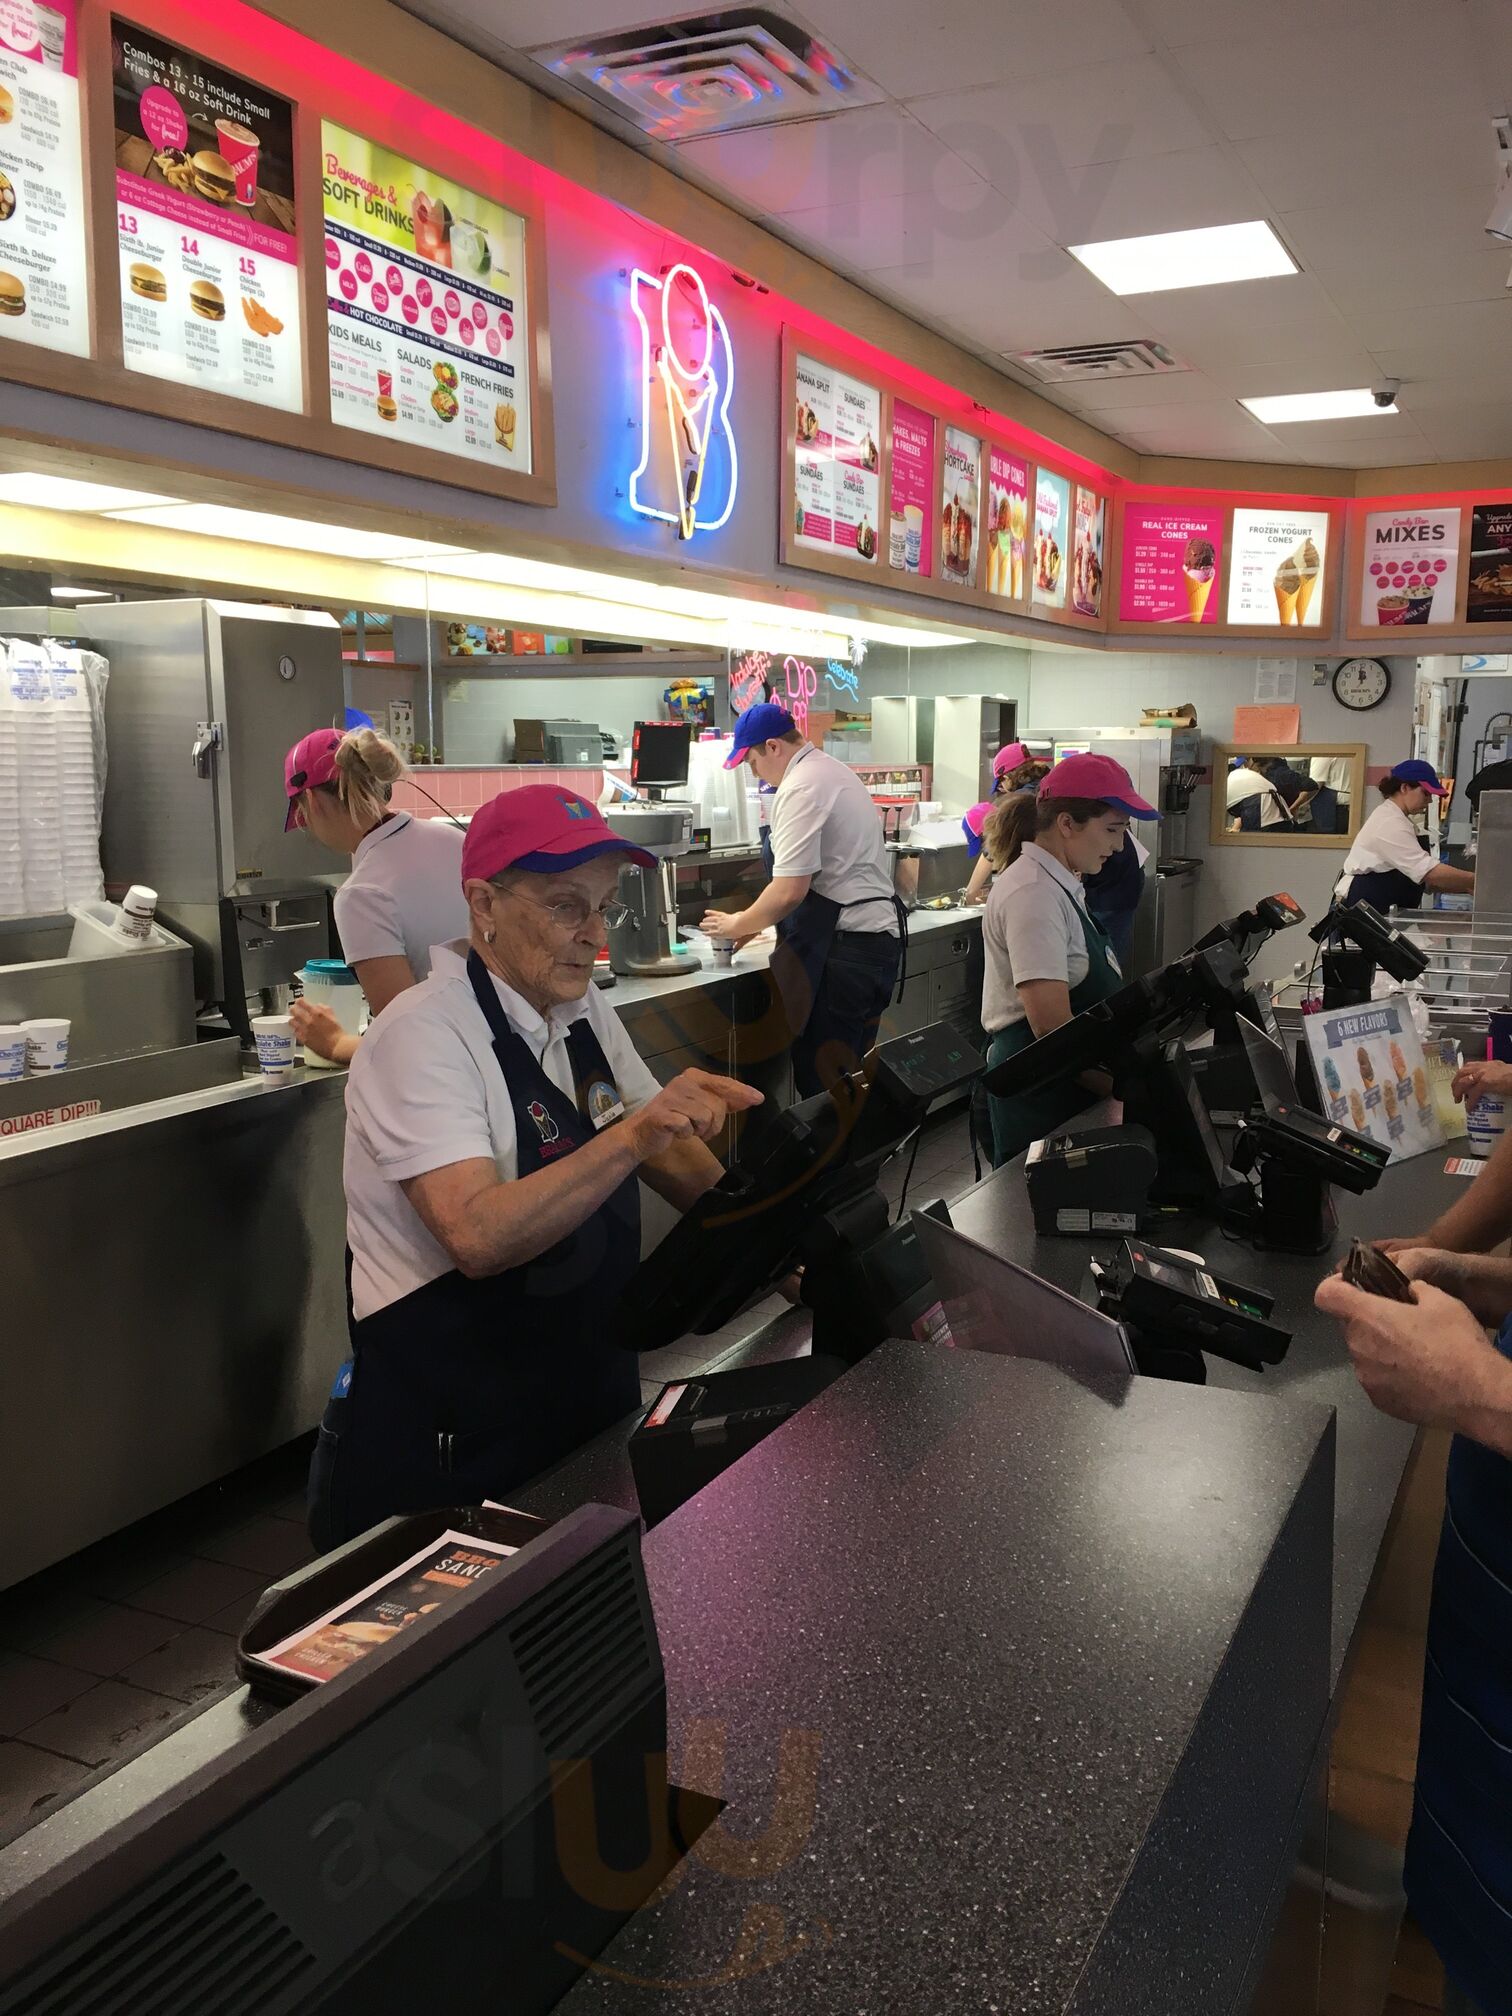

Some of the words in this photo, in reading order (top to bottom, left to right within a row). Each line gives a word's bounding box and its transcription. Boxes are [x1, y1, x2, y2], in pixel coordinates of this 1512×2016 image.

[10, 60, 28, 74] Club
[123, 42, 166, 70] Combos
[169, 63, 182, 78] 13
[192, 74, 205, 88] 15
[207, 80, 242, 106] include
[244, 98, 270, 119] Small
[124, 57, 150, 78] Fries
[152, 71, 160, 84] &
[164, 79, 170, 88] a
[174, 80, 186, 95] 16
[189, 91, 200, 102] oz
[203, 94, 224, 112] Soft
[226, 104, 252, 126] Drink
[25, 159, 44, 172] Strip
[325, 154, 386, 203] Beverages
[384, 186, 398, 207] &
[142, 196, 166, 212] Cottage
[148, 187, 166, 200] Greek
[167, 194, 186, 208] Yogurt
[323, 178, 361, 210] SOFT
[364, 200, 414, 235] DRINKS
[119, 213, 138, 234] 13
[120, 234, 136, 244] Sixth
[146, 242, 166, 255] Junior
[180, 236, 199, 257] 14
[254, 234, 268, 248] FOR
[0, 240, 18, 252] Sixth
[20, 246, 29, 256] lb.
[32, 249, 57, 264] Deluxe
[0, 251, 51, 272] Cheeseburger
[120, 244, 162, 263] Cheeseburger
[182, 254, 202, 268] Double
[204, 262, 222, 274] Junior
[182, 264, 222, 283] Cheeseburger
[239, 256, 256, 276] 15
[28, 274, 48, 287] COMBO
[240, 276, 261, 288] Chicken
[350, 306, 364, 320] HOT
[365, 312, 404, 336] CHOCOLATE
[328, 322, 349, 341] KIDS
[352, 330, 382, 352] MEALS
[397, 348, 432, 371] SALADS
[460, 372, 492, 392] FRENCH
[493, 382, 514, 400] FRIES
[816, 380, 830, 396] SPLIT
[844, 392, 866, 410] SUNDAES
[900, 440, 921, 458] FREEZES
[911, 432, 928, 448] MALTS
[800, 465, 824, 482] SUNDAES
[1002, 462, 1010, 480] DIP
[1010, 466, 1024, 488] CONES
[843, 480, 865, 496] SUNDAES
[1142, 521, 1162, 530] REAL
[1165, 522, 1178, 530] ICE
[1180, 522, 1208, 531] CREAM
[1248, 526, 1279, 535] FROZEN
[1281, 528, 1312, 536] YOGURT
[1392, 518, 1414, 528] Candy
[1414, 516, 1429, 526] Bar
[1487, 524, 1512, 535] ANY
[1161, 531, 1188, 540] CONES
[1267, 536, 1293, 544] CONES
[1376, 524, 1445, 544] MIXES
[1337, 1021, 1343, 1036] 6
[1343, 1017, 1359, 1036] NEW
[1360, 1012, 1388, 1032] FLAVORS
[1, 1111, 55, 1136] QUARE
[61, 1101, 98, 1122] DIP!!!
